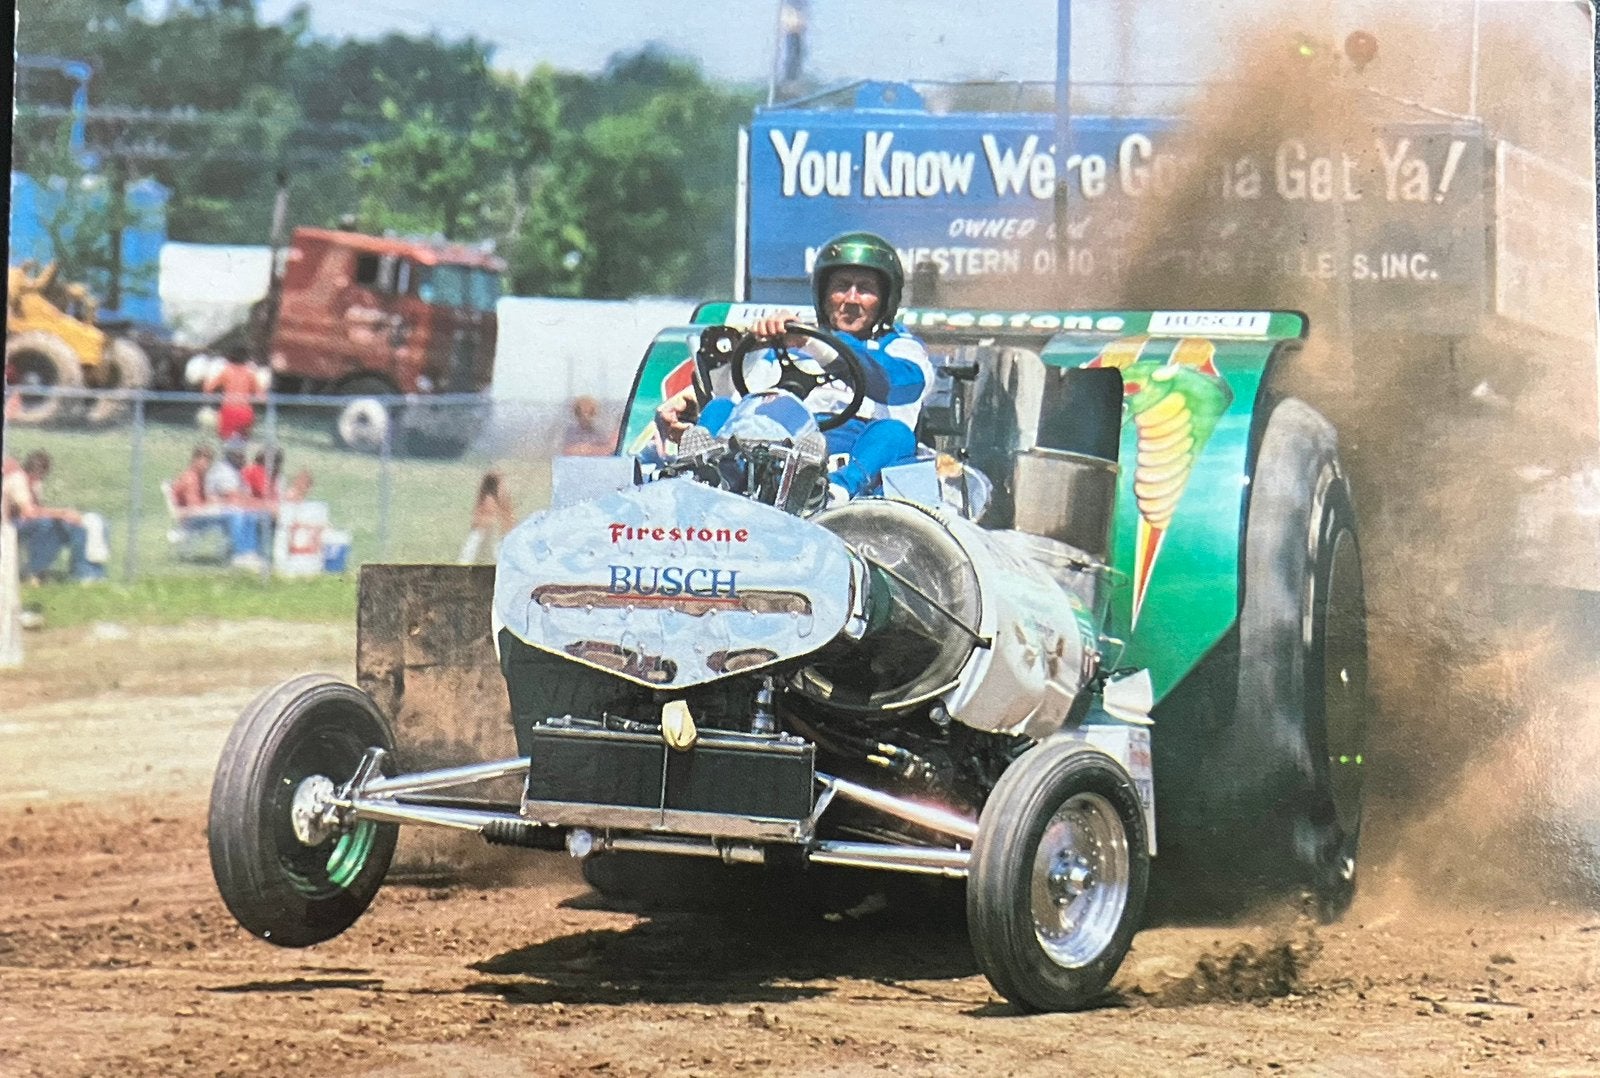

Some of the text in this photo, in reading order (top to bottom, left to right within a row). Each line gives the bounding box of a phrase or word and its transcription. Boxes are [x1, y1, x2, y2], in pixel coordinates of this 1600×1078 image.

[769, 129, 851, 197] You
[863, 130, 975, 198] Know
[1276, 138, 1364, 202] Get
[1375, 137, 1467, 204] Ya!
[949, 218, 1036, 240] OWNED
[902, 308, 1125, 331] irestone
[608, 522, 749, 543] Firestone
[607, 563, 742, 599] BUSCH
